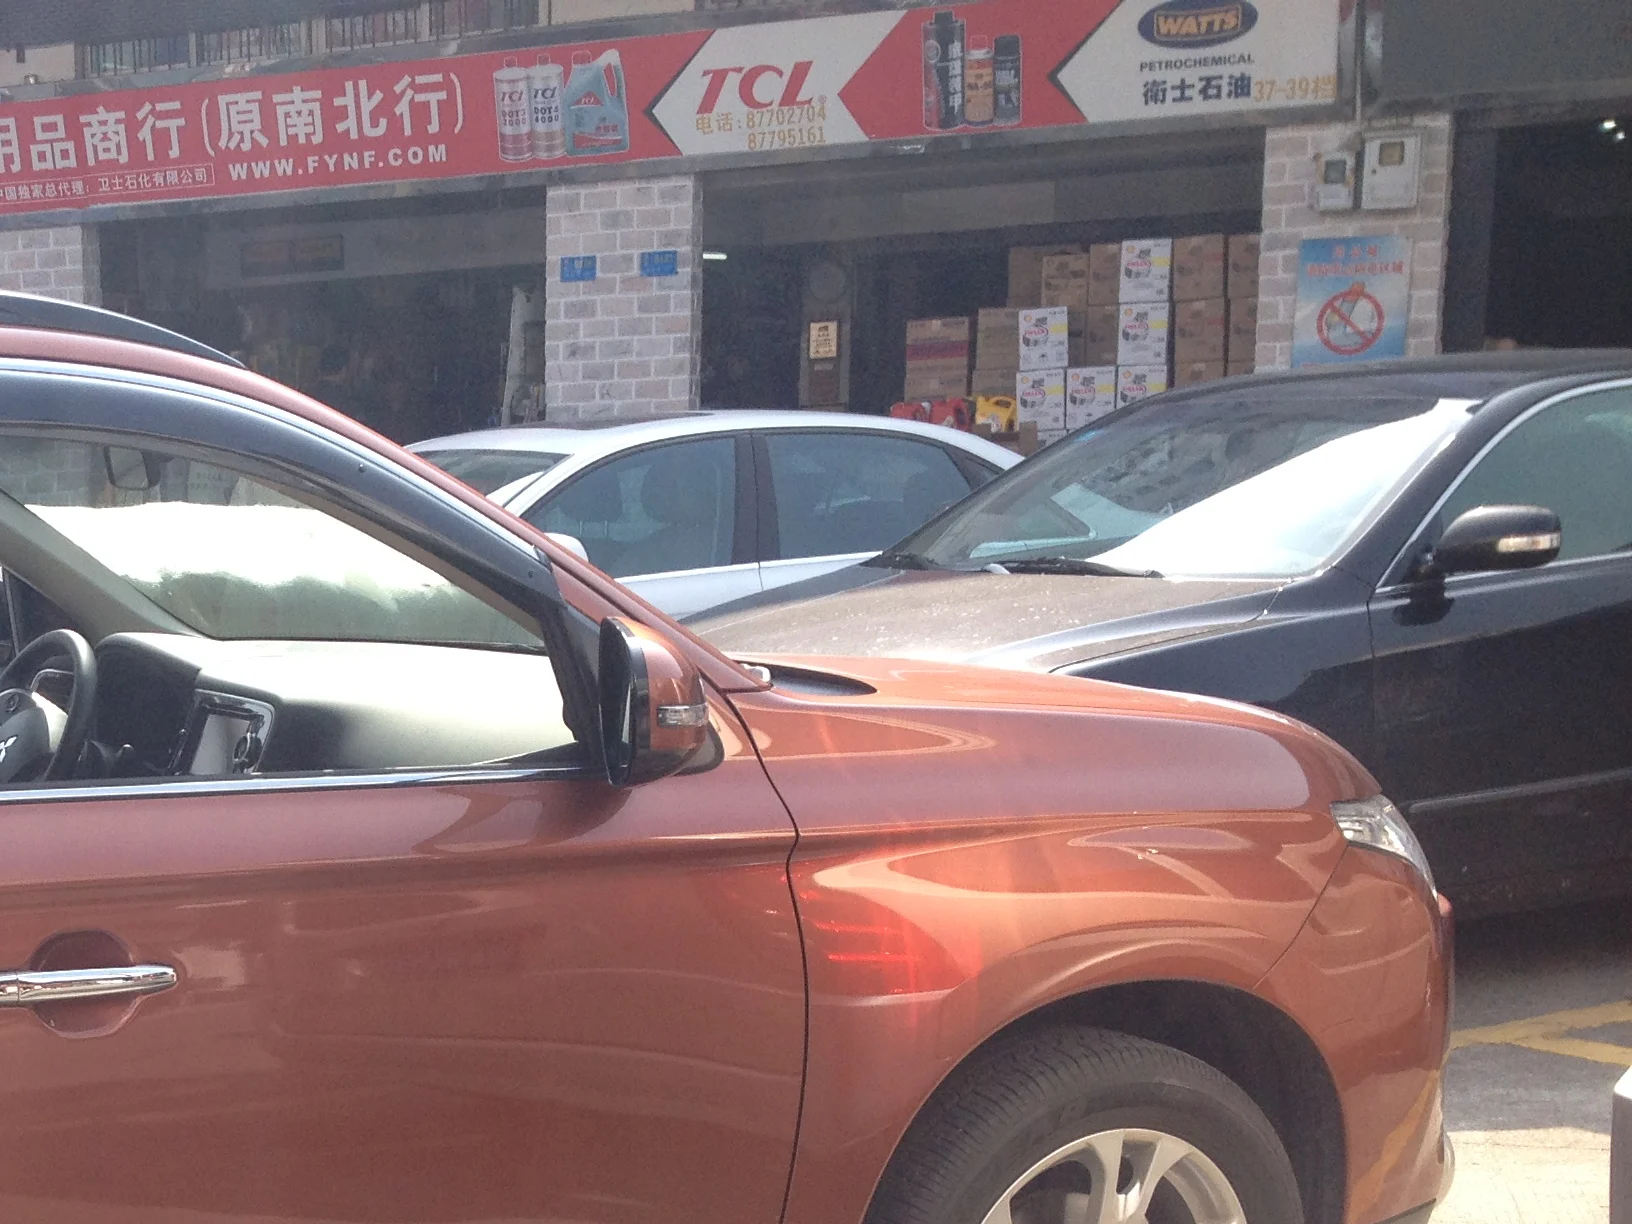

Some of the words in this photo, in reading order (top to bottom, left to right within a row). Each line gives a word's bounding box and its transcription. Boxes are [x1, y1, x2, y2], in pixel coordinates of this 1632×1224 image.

[1157, 12, 1240, 36] WATTS
[1139, 53, 1255, 72] PETROCHEMICAL
[696, 60, 814, 115] TCL
[747, 125, 826, 151] 87795161
[228, 143, 448, 181] WWW.FYNF.COM
